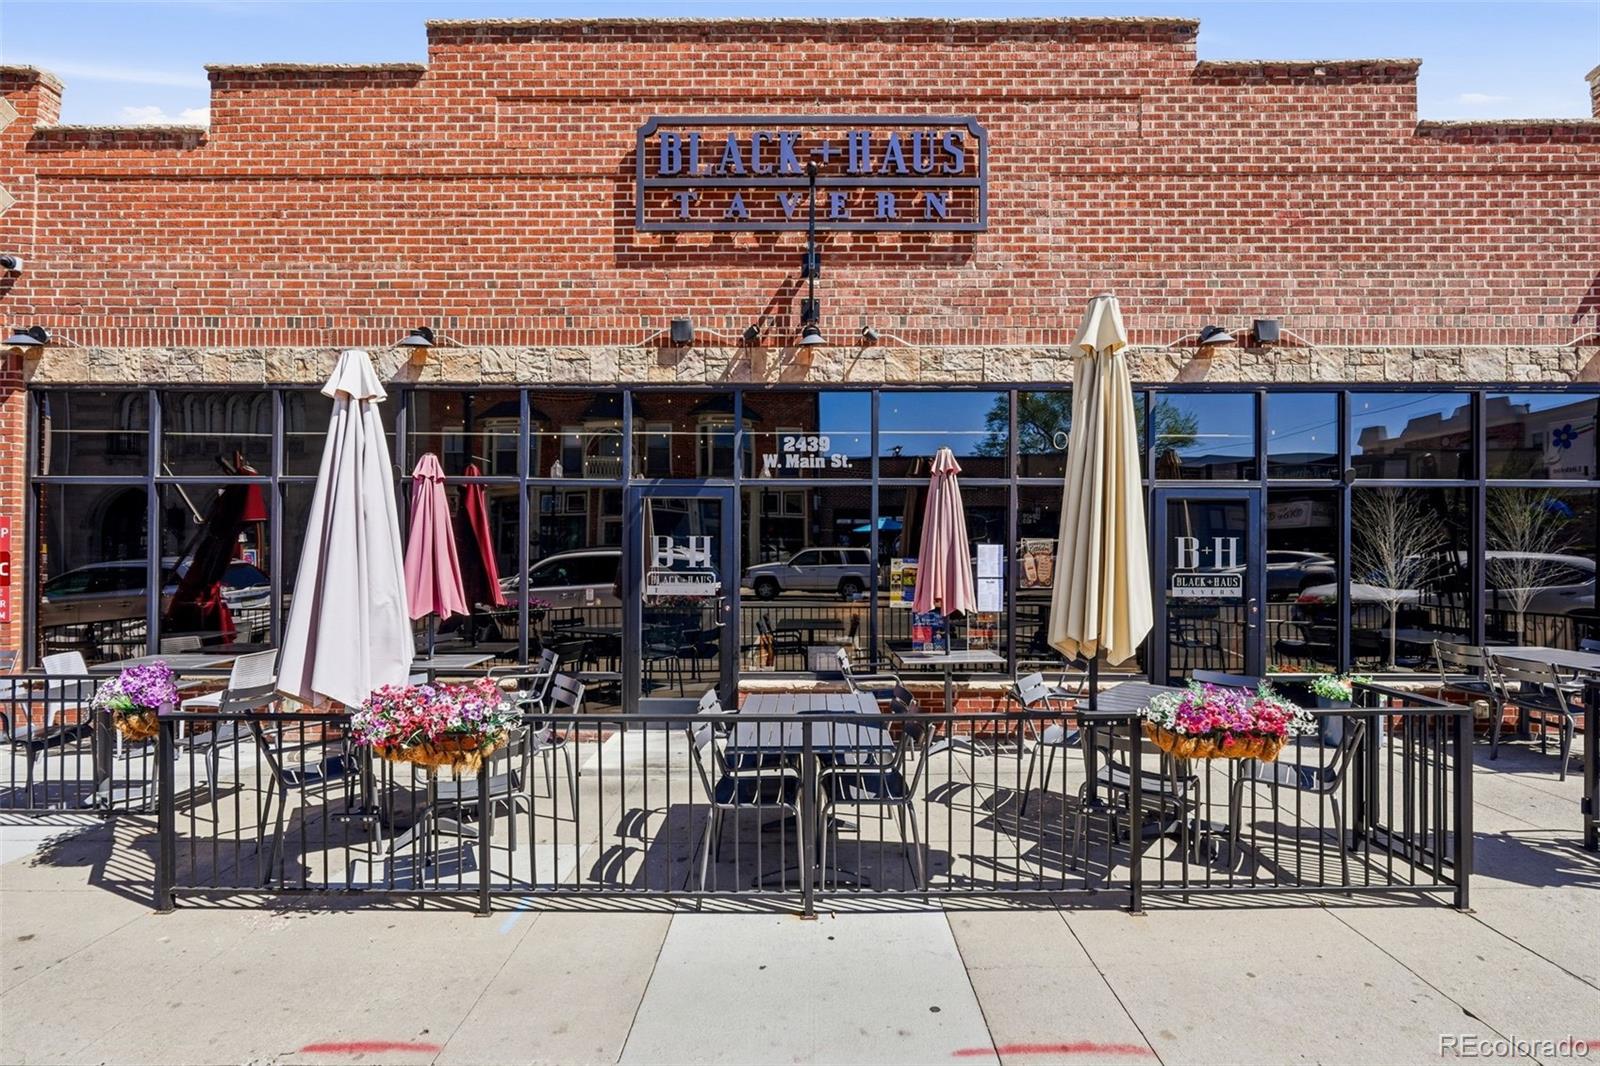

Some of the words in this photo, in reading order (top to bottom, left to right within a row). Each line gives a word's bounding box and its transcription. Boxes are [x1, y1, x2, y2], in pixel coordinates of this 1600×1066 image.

[658, 131, 801, 175] BLACK
[846, 130, 965, 174] HAUS
[673, 191, 949, 219] TAVERN
[783, 436, 830, 452] 2439
[762, 453, 782, 469] W.
[785, 453, 825, 468] Main
[830, 453, 853, 469] St.
